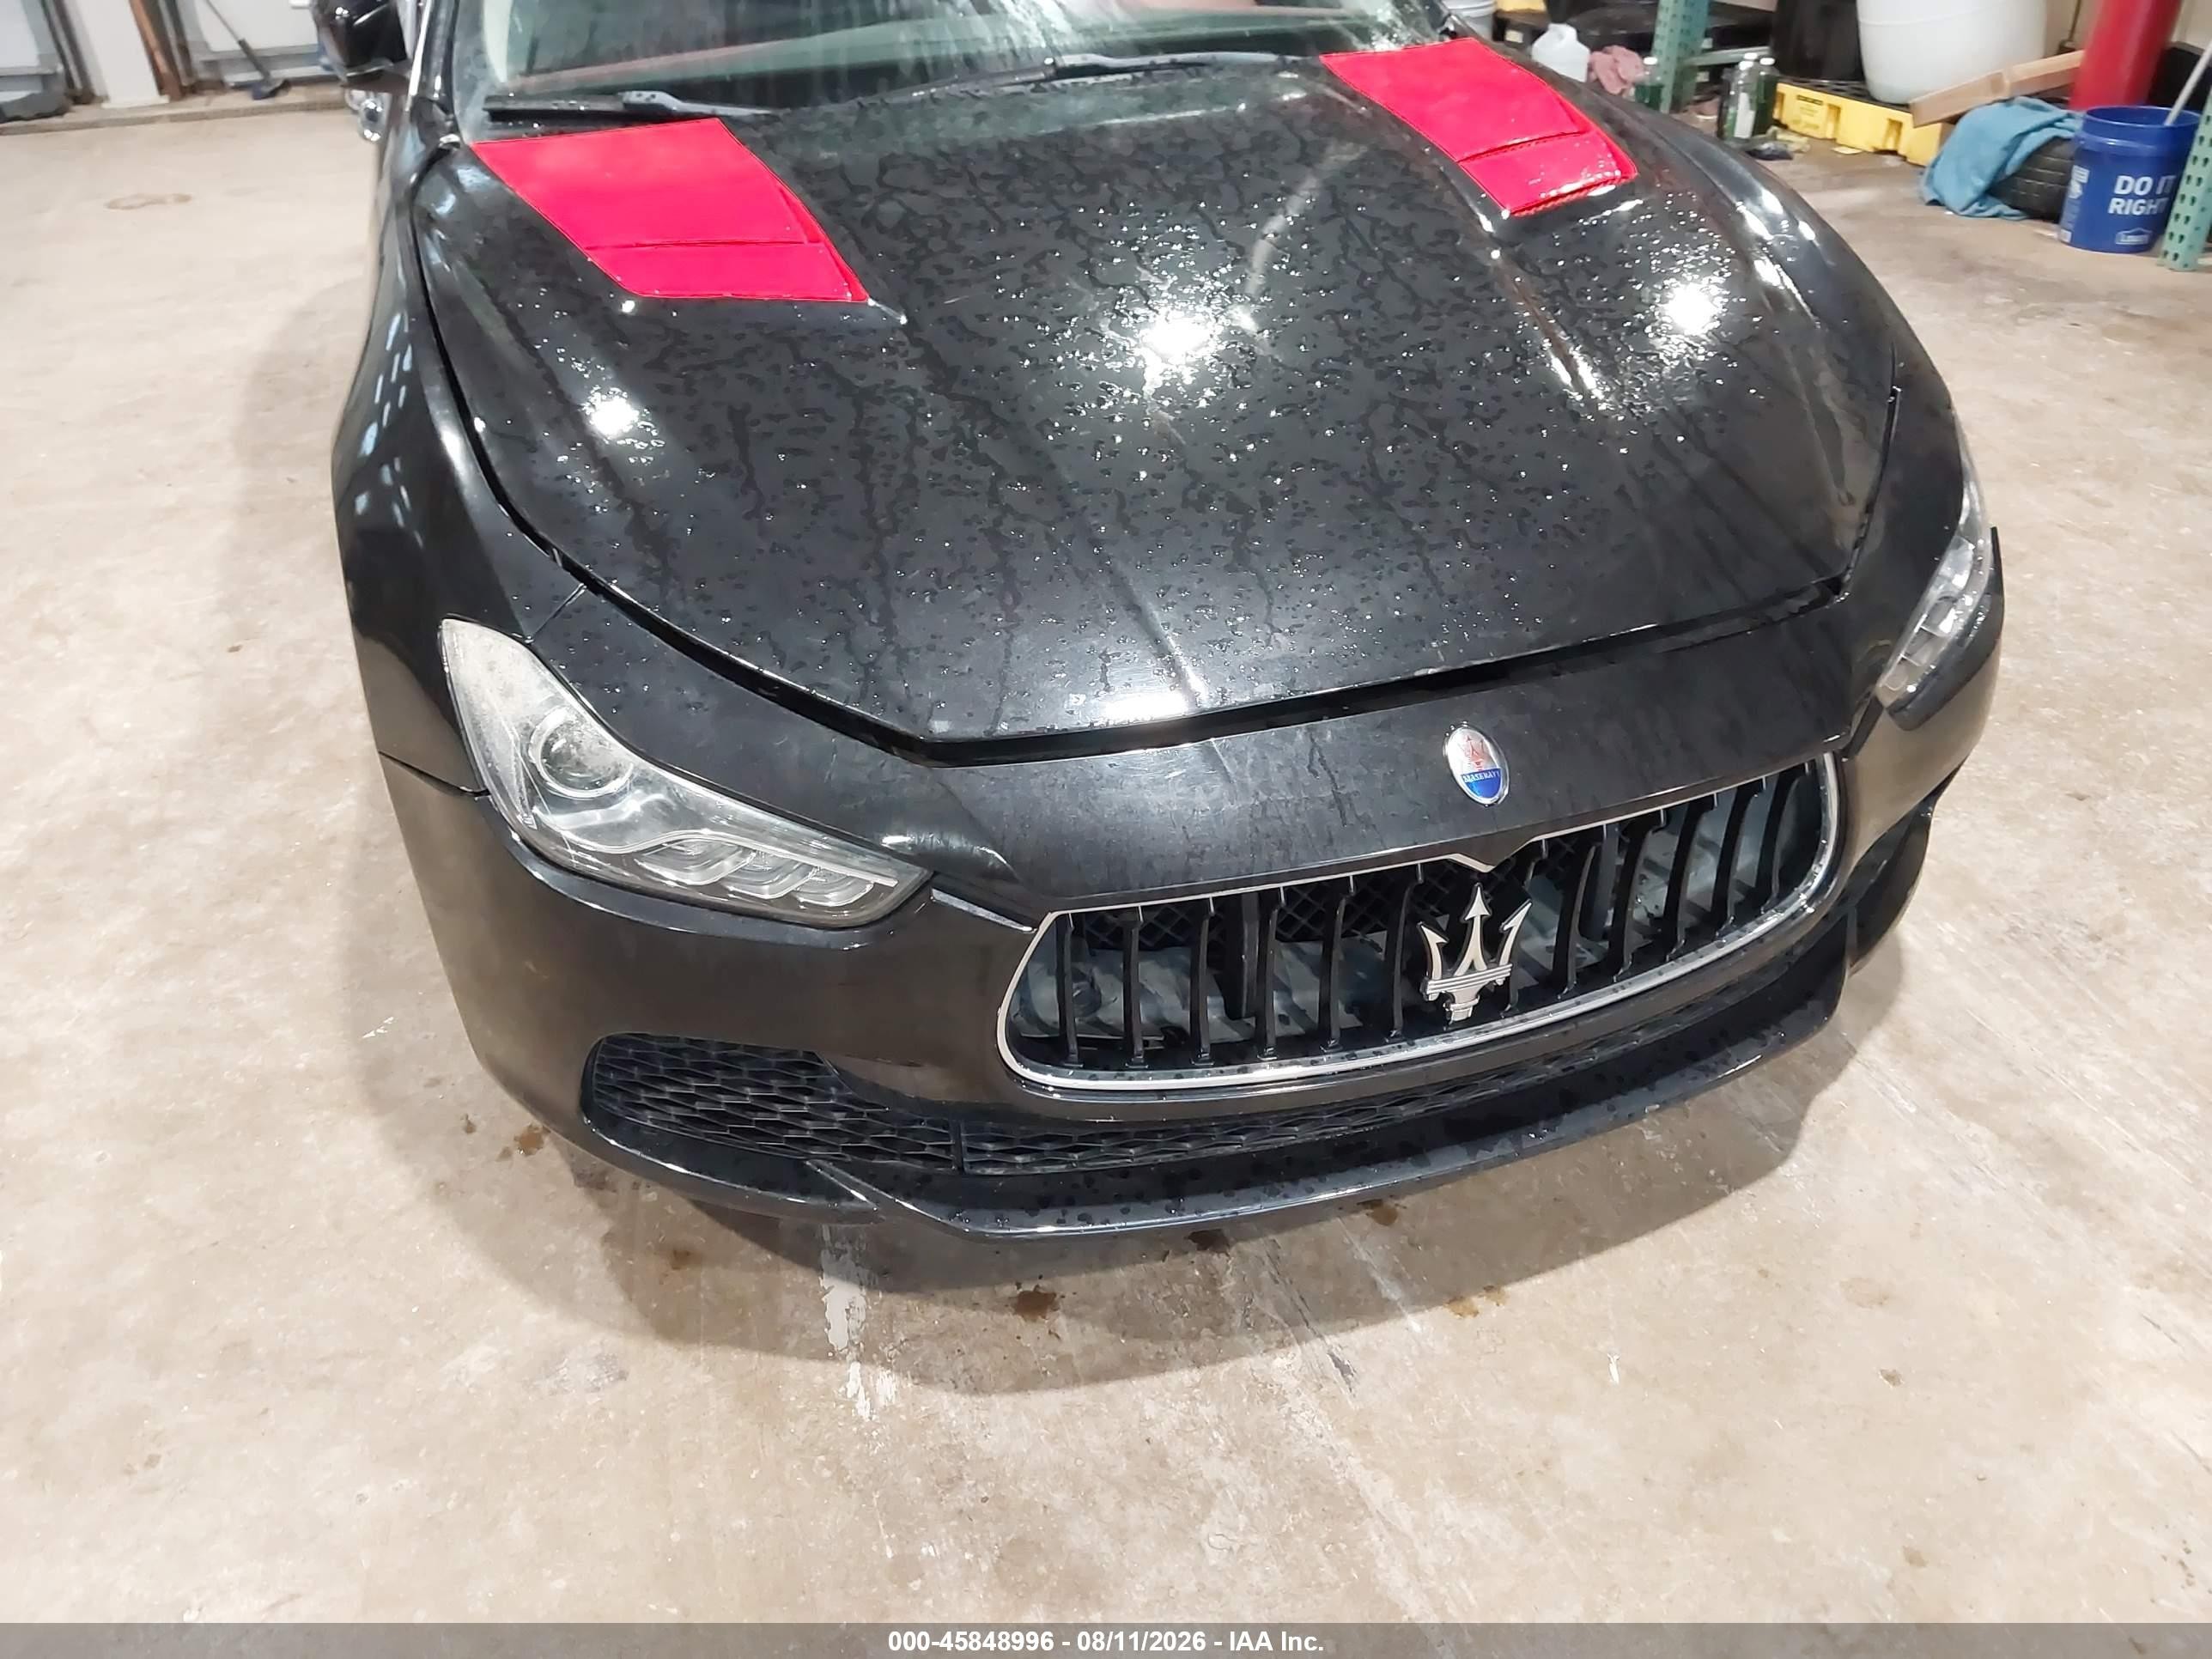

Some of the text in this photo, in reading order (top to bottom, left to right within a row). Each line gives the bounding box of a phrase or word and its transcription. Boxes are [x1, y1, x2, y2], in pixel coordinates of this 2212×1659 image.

[2113, 175, 2177, 196] DO IT
[2107, 198, 2170, 216] RIGHT
[1462, 769, 1501, 783] MASERATI
